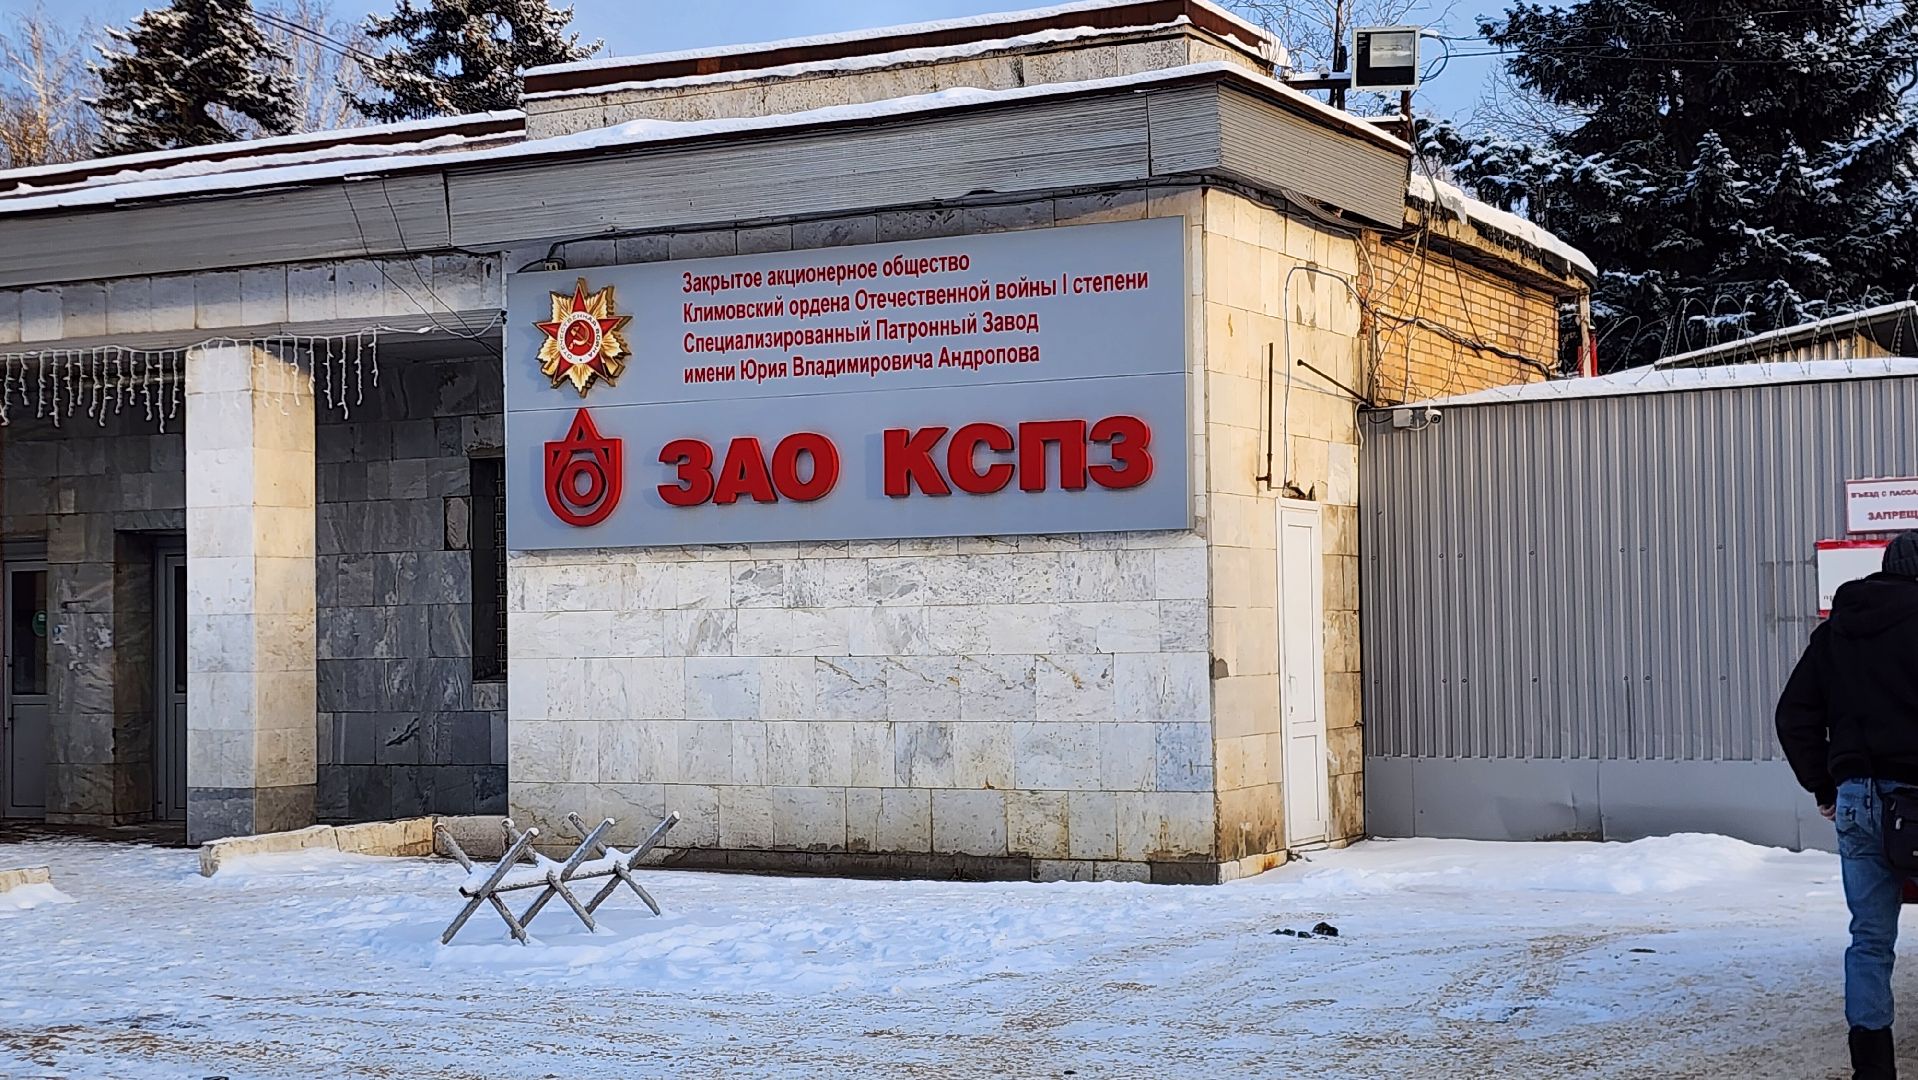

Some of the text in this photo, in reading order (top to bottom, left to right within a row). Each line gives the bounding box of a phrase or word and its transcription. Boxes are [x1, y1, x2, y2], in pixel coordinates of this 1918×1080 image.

[682, 254, 971, 295] Закрытое акционерное общество
[682, 271, 1149, 323] Климовский ордена Отечественной войны I степени
[682, 311, 1040, 354] Специализированный Патронный Завод
[683, 345, 1041, 384] имени Юрия Владимировича Андропова
[657, 415, 1155, 507] ЗАО КСПЗ
[1850, 491, 1880, 499] ВЪЕЗД
